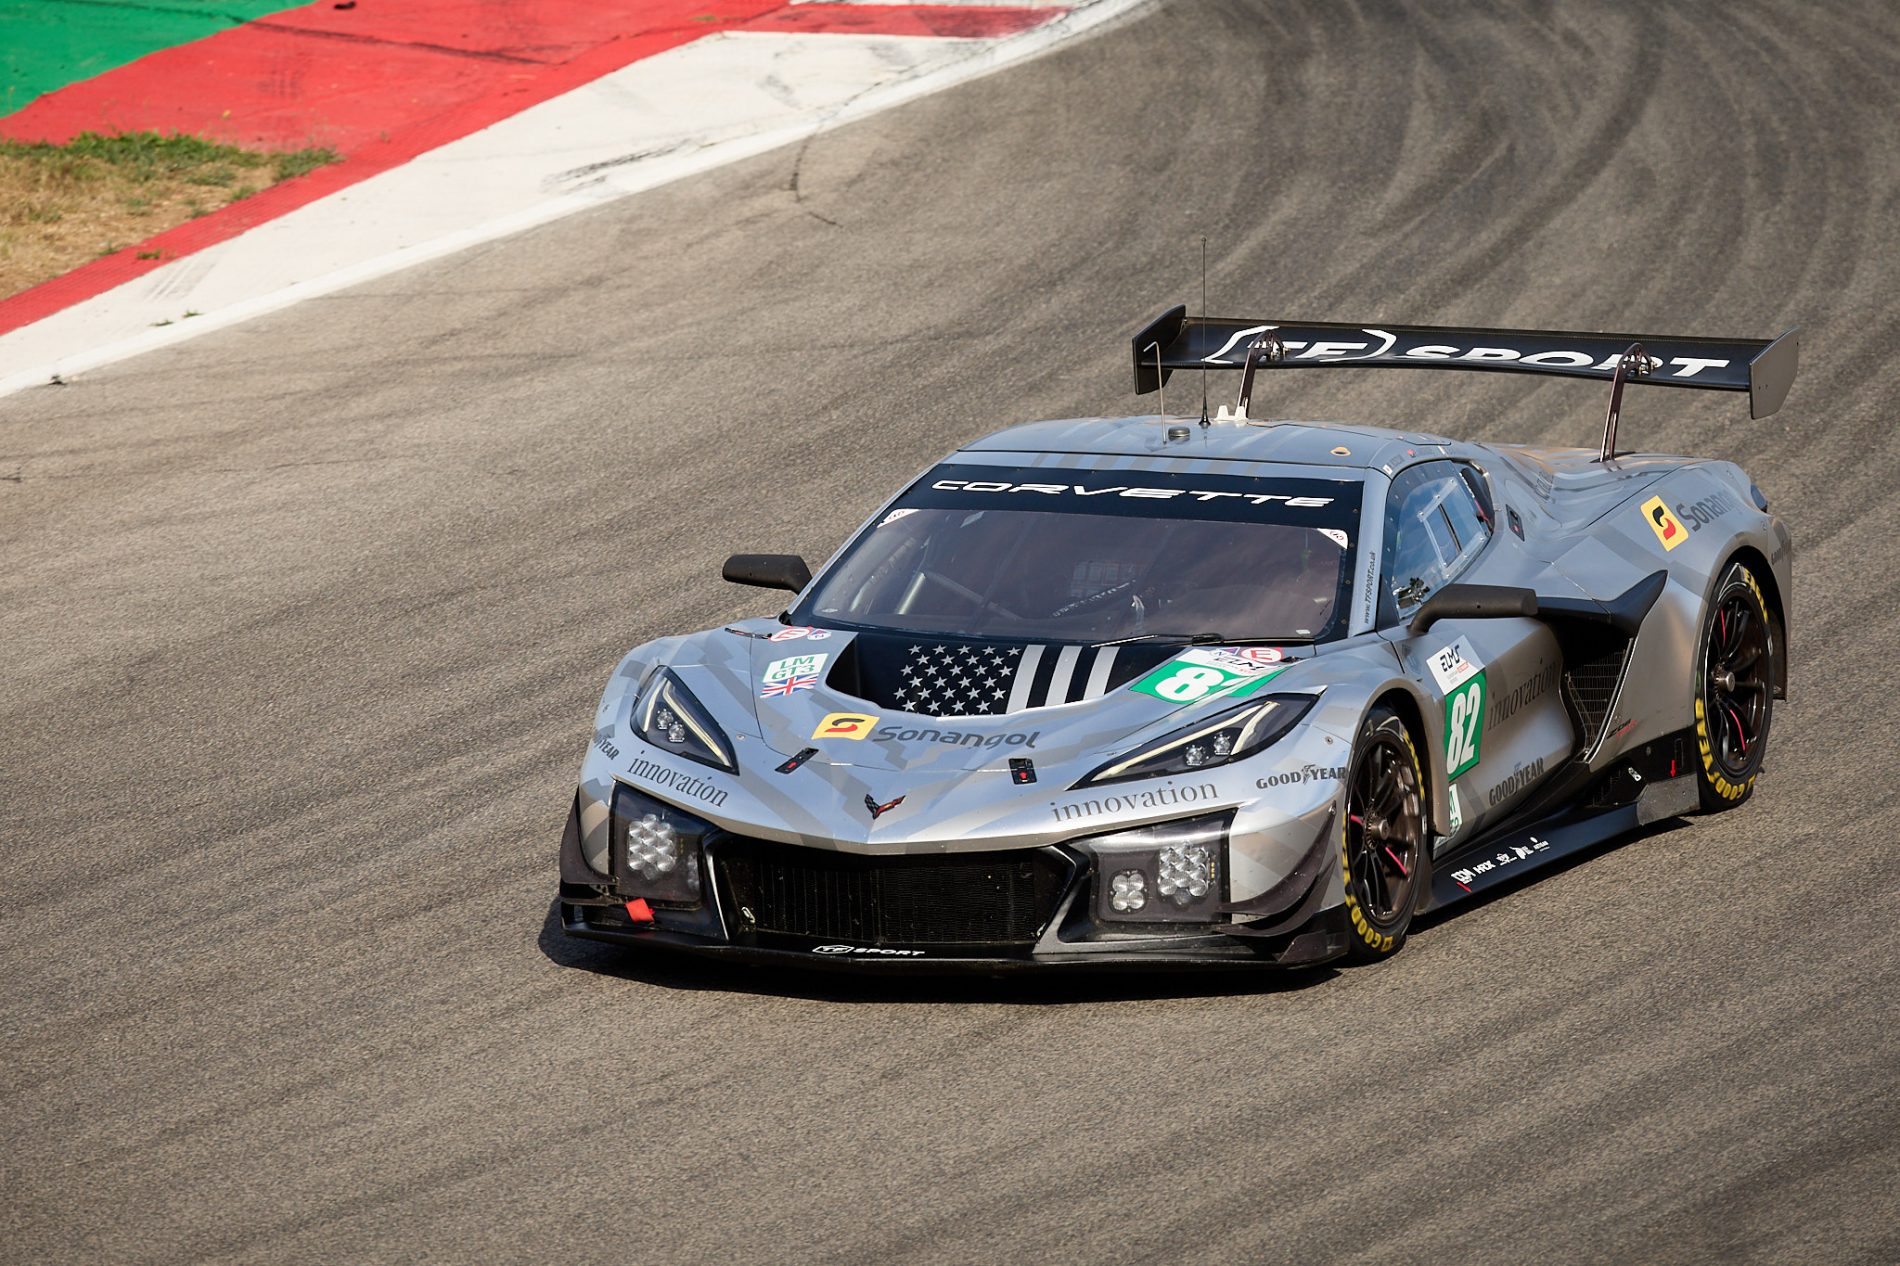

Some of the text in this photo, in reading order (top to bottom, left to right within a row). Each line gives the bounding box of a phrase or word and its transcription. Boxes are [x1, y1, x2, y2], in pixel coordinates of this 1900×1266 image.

[1393, 345, 1730, 377] SPORT
[931, 479, 1335, 508] CORVETTE
[771, 664, 815, 680] GT3
[780, 656, 815, 669] LM
[872, 725, 1041, 750] Sonangol
[1446, 682, 1481, 775] 82
[627, 750, 729, 808] innovation
[1256, 765, 1347, 790] GOODYEAR
[1488, 757, 1545, 806] GOODYEAR
[1050, 780, 1220, 822] innovation
